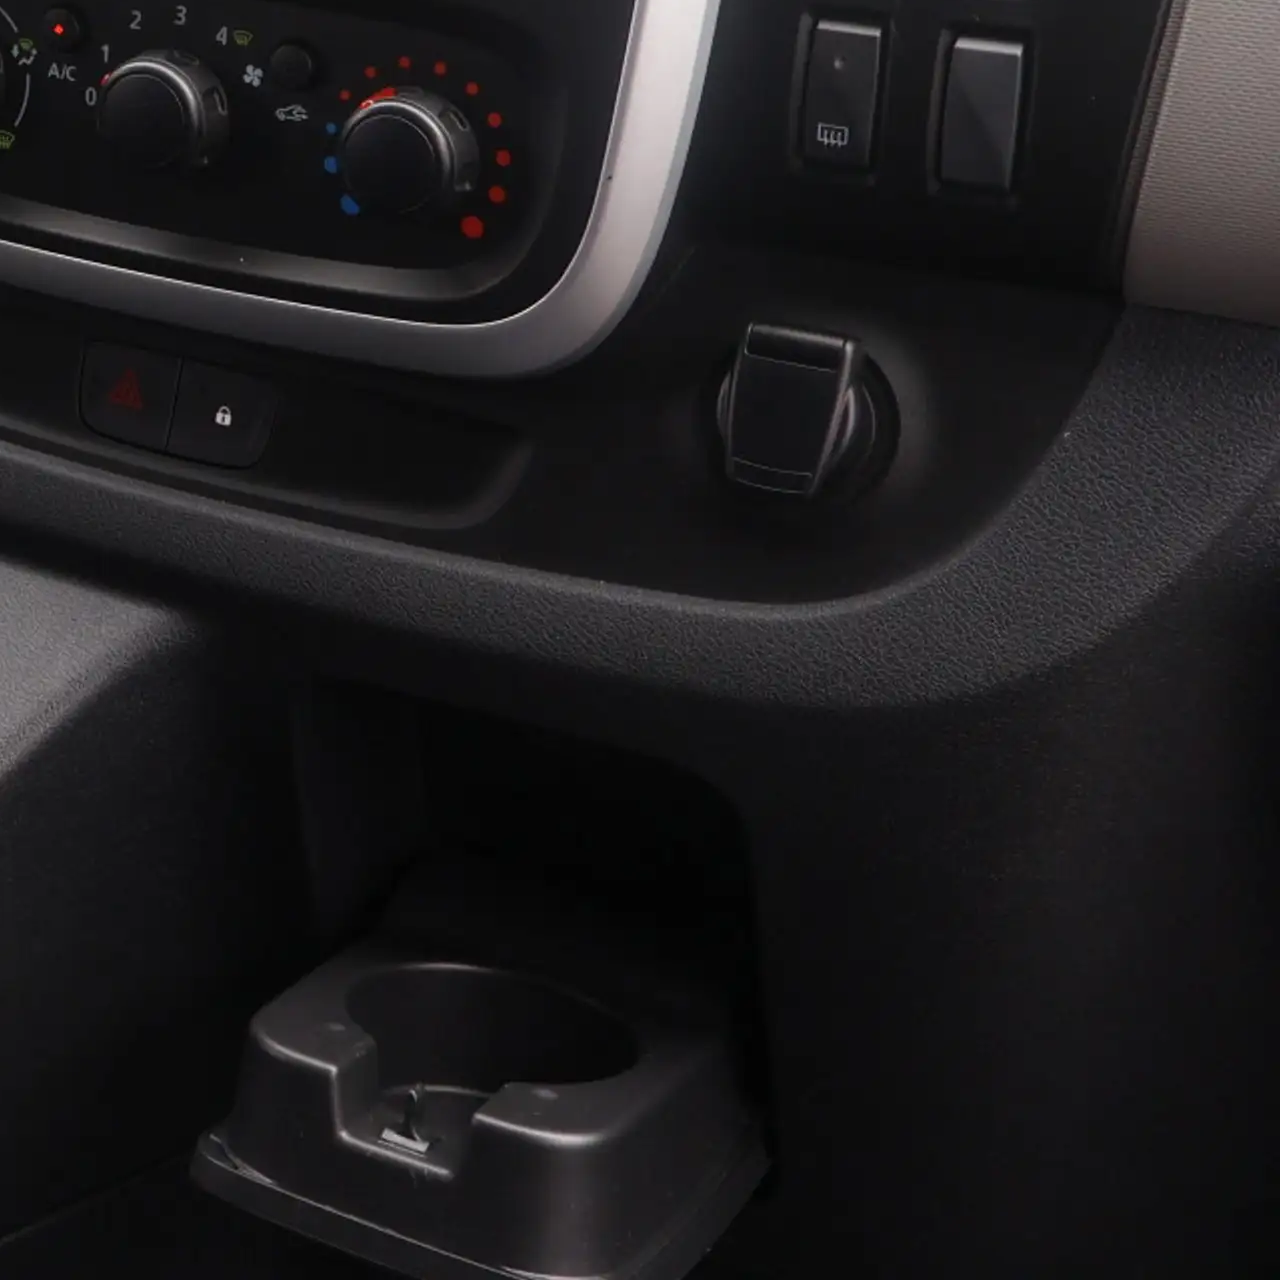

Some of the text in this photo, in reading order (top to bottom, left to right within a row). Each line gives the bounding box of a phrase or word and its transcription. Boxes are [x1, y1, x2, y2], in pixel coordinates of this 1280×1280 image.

[129, 10, 142, 30] 2
[174, 5, 187, 26] 3
[215, 26, 228, 46] 4
[100, 44, 111, 65] 1
[47, 62, 77, 82] A/C
[84, 86, 98, 107] 0
